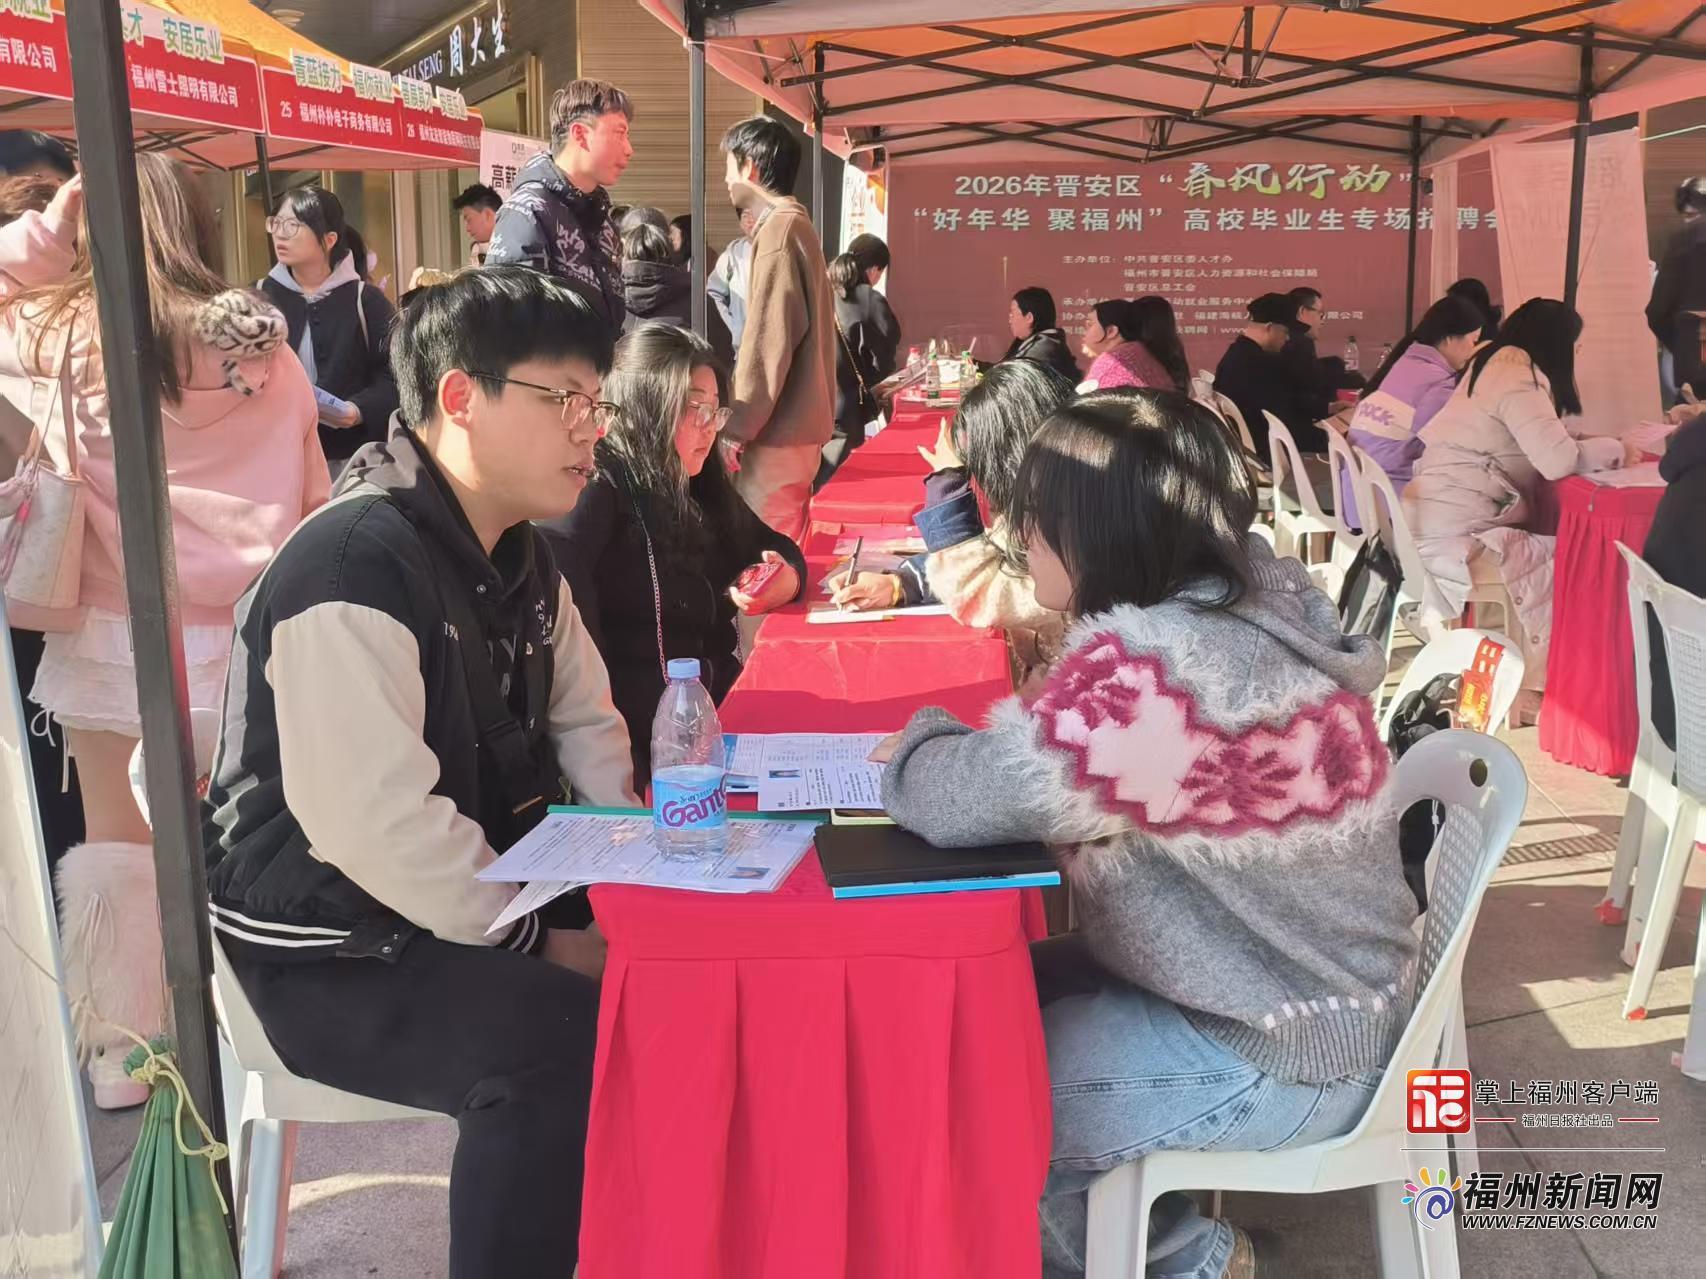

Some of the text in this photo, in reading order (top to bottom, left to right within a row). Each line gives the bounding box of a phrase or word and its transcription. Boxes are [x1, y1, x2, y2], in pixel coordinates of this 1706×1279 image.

[163, 17, 223, 60] 安居乐业
[449, 0, 506, 77] 周大生
[131, 63, 239, 108] 福州雷士照明有限公司
[280, 100, 293, 118] 25
[955, 174, 1143, 198] 2026年晋安区
[913, 207, 1031, 232] “好年华
[1047, 207, 1163, 232] 聚福州”
